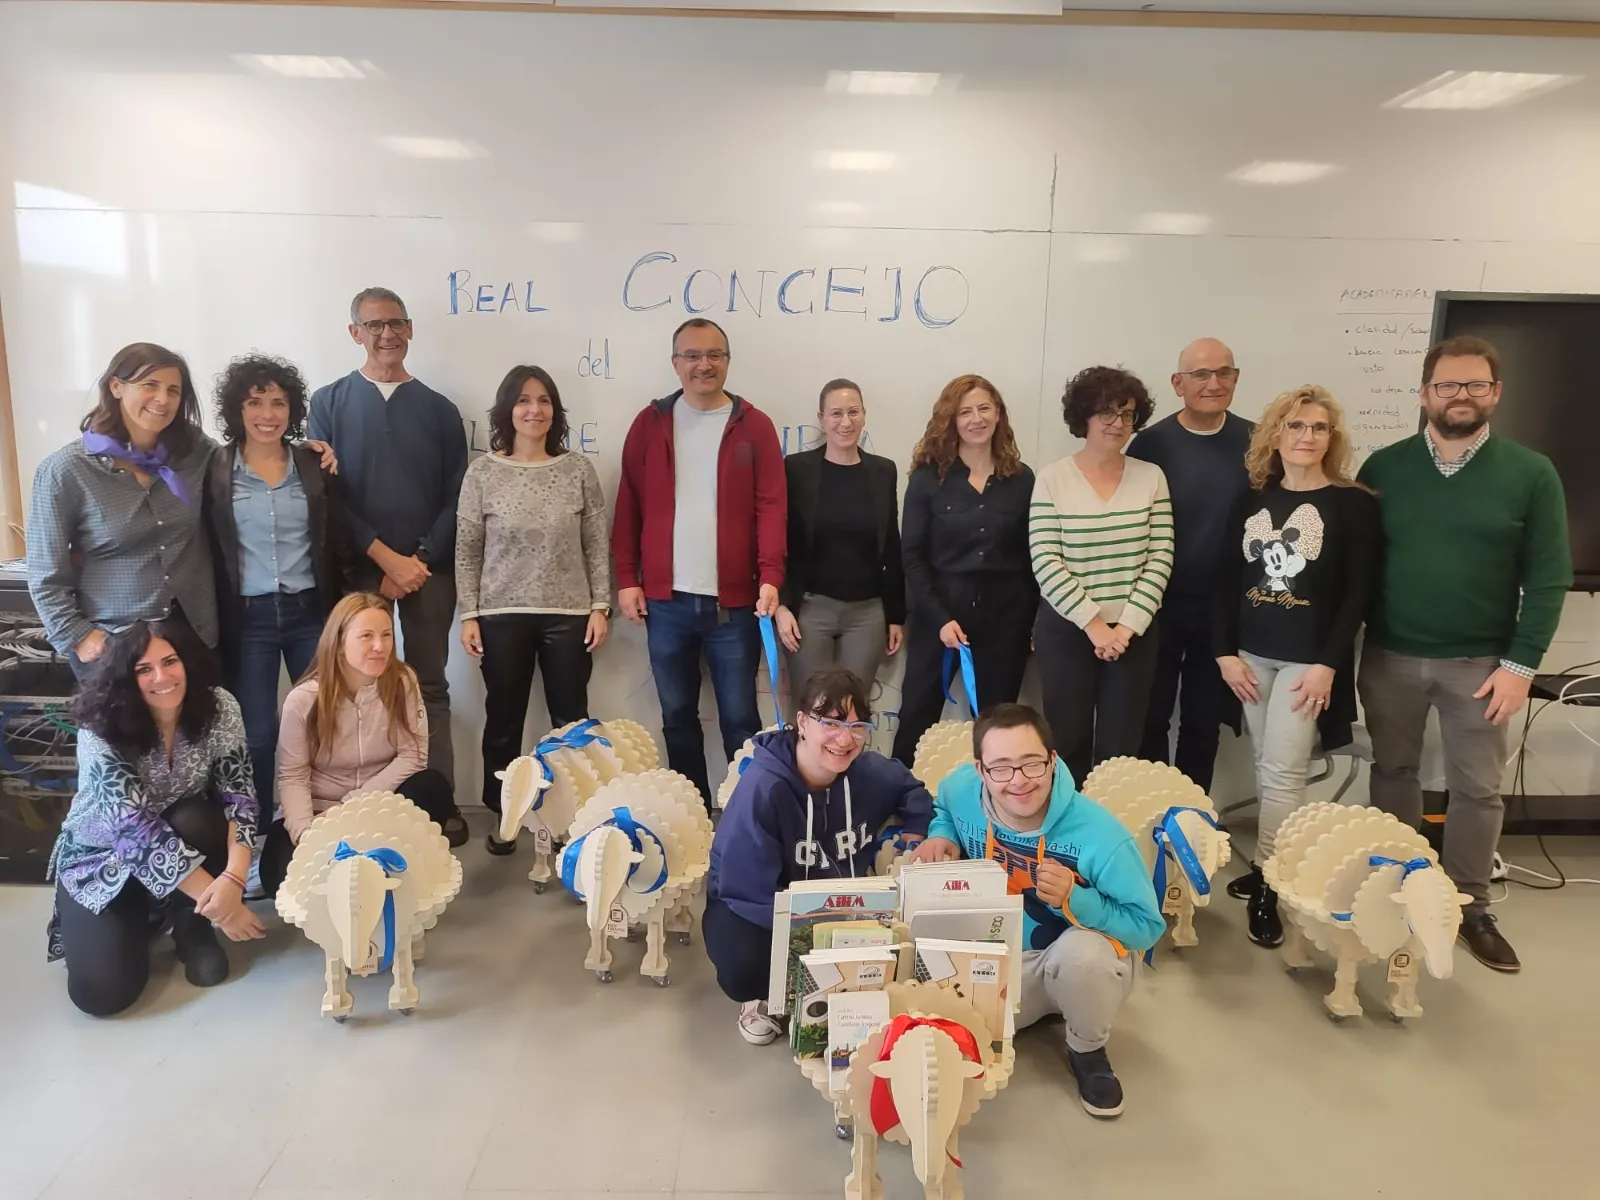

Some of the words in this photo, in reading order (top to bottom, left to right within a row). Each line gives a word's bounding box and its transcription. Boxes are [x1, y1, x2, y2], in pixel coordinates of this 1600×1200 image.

[448, 269, 550, 315] REAL
[622, 251, 970, 329] CONCEJO
[577, 337, 615, 380] del
